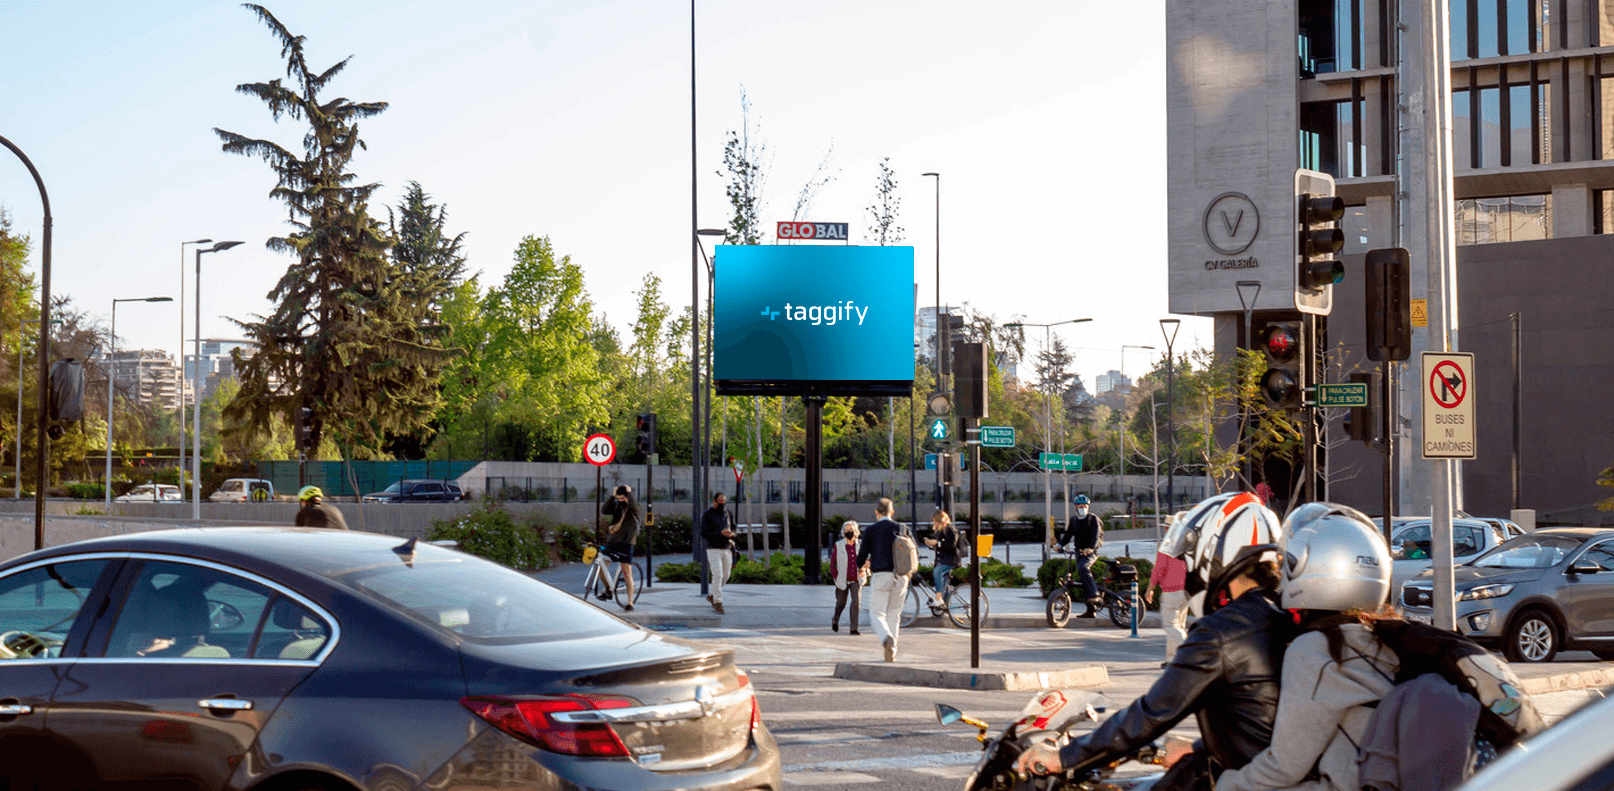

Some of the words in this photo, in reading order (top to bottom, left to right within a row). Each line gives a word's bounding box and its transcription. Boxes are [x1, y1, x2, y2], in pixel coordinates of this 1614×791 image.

[1220, 209, 1244, 238] V
[778, 223, 847, 239] GLOBAL
[1204, 260, 1219, 271] CV
[784, 301, 869, 326] taggify
[1435, 414, 1465, 425] BUSES
[1445, 428, 1455, 438] NI
[590, 443, 610, 457] 40
[1426, 441, 1472, 452] CAMIONES
